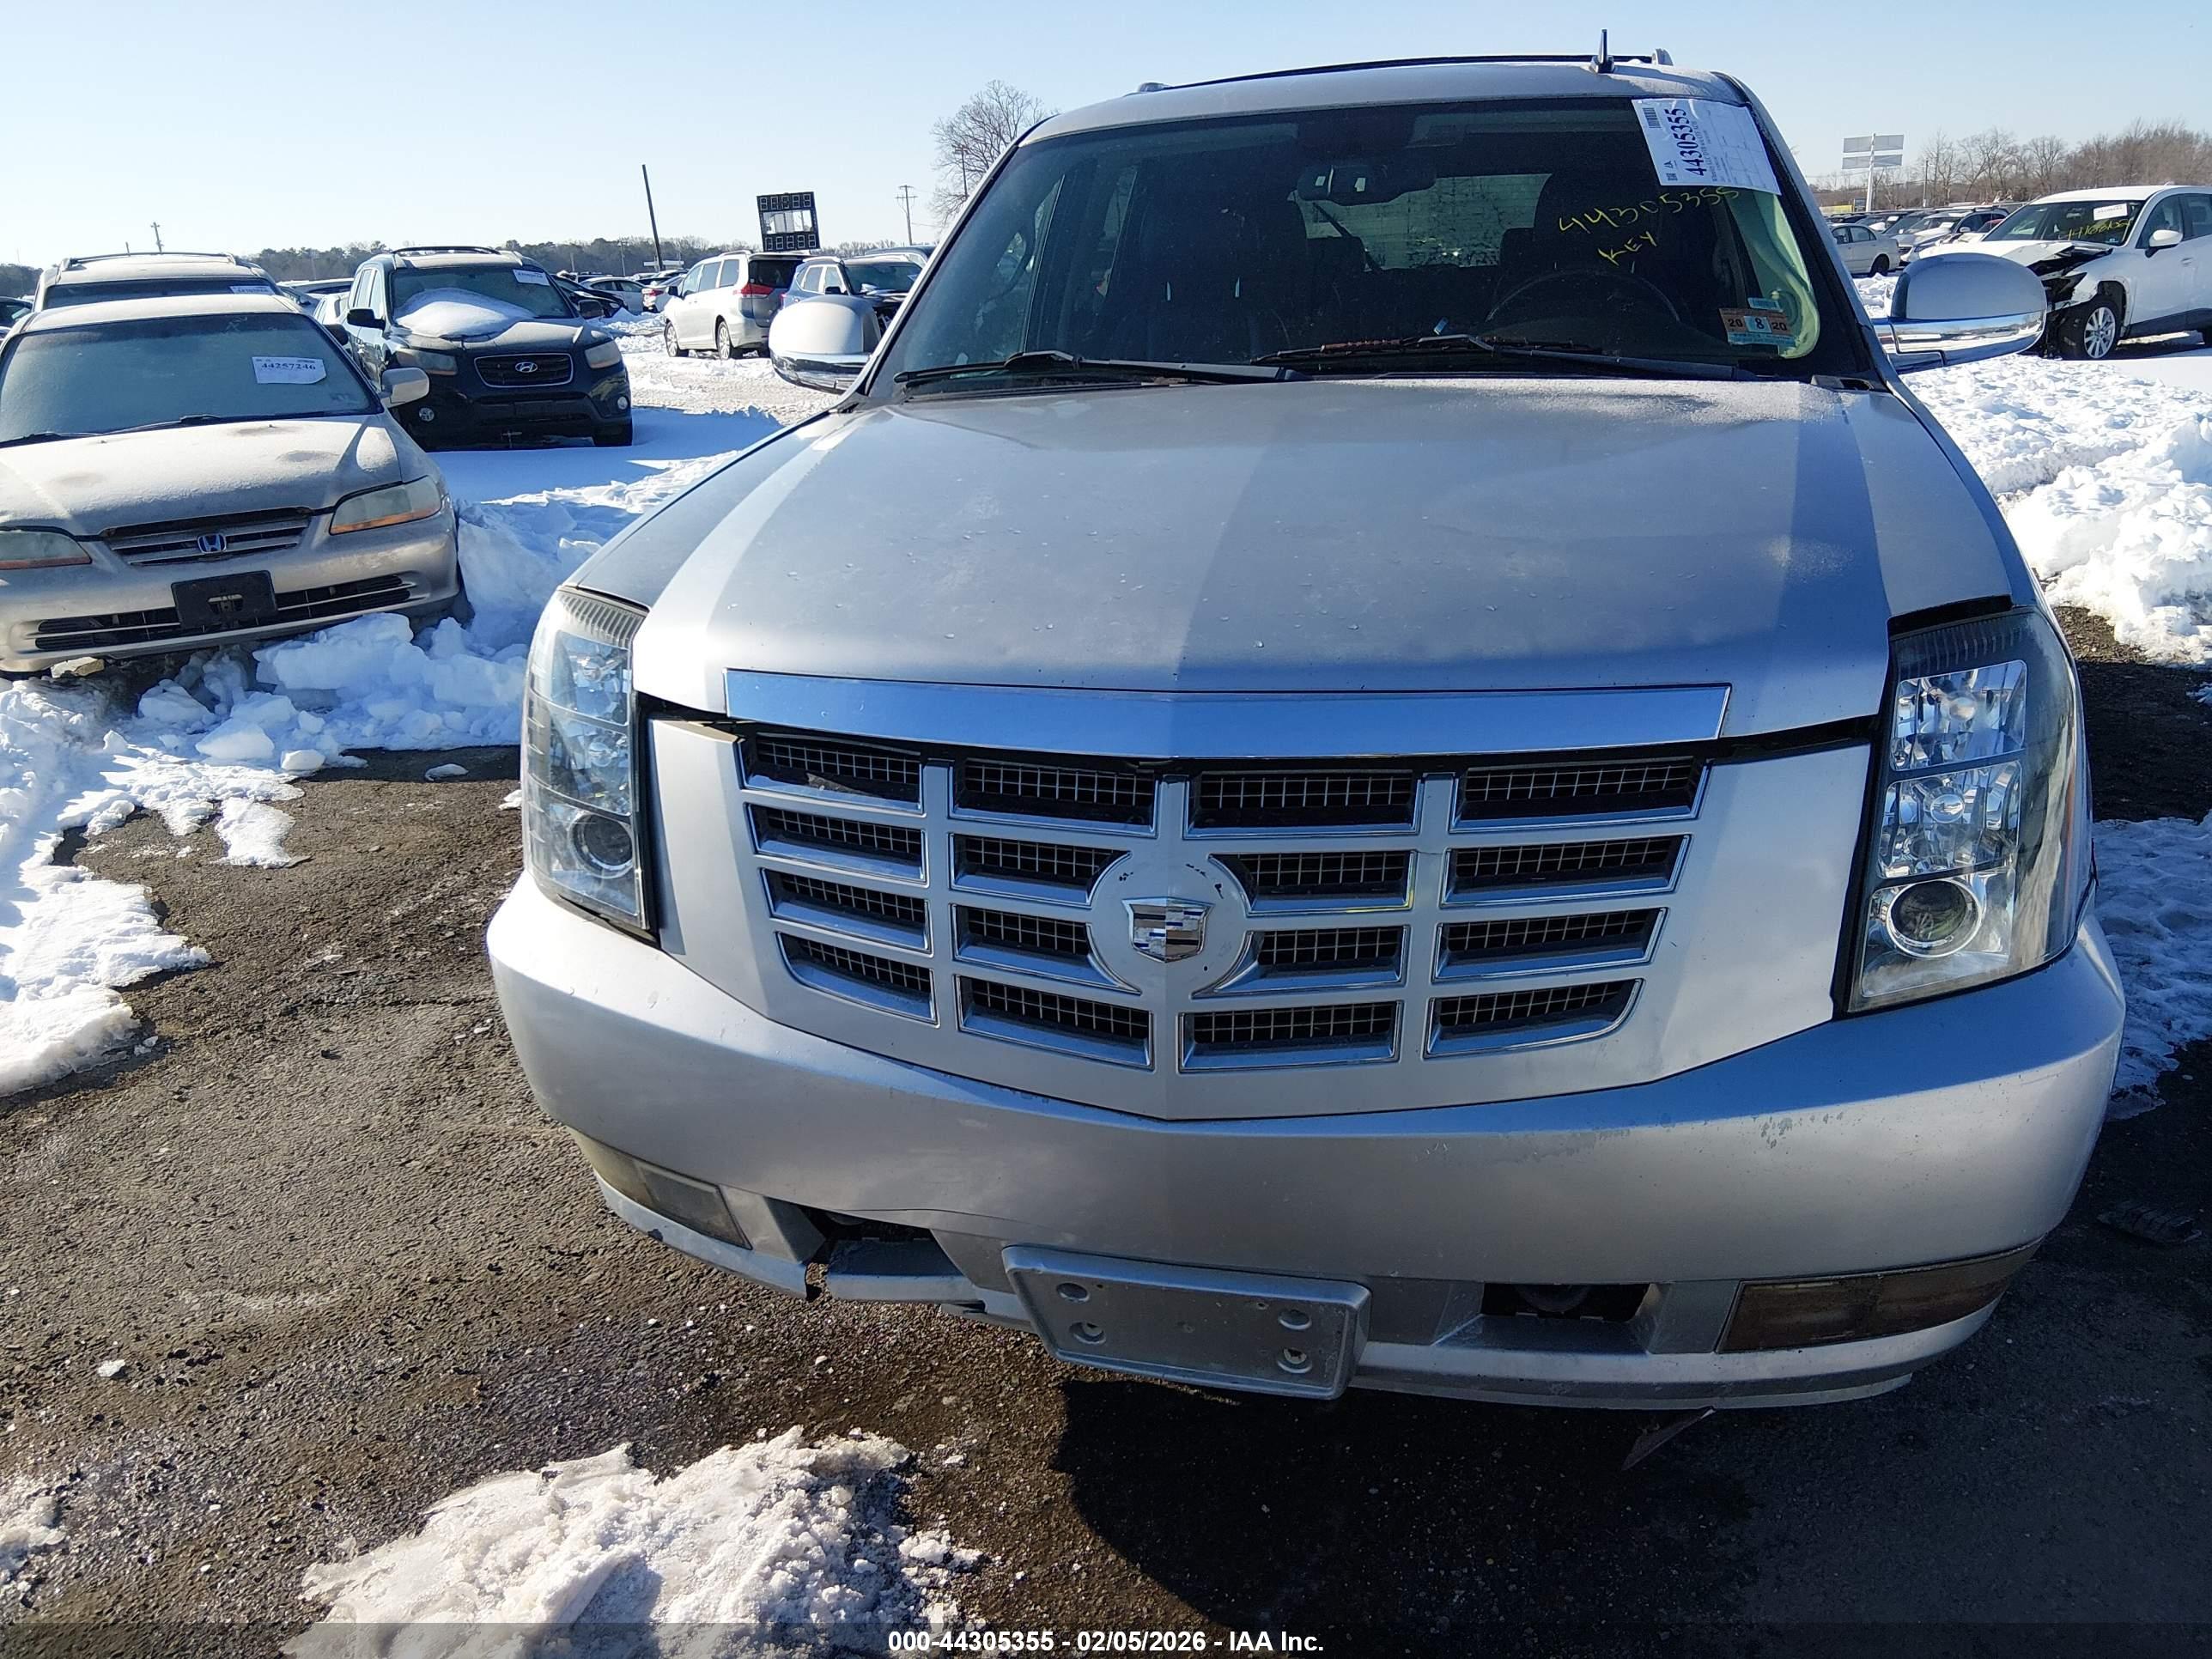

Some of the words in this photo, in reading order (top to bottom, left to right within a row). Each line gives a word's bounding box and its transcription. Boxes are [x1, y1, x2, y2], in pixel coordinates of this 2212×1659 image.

[1664, 108, 1707, 177] 44305355
[1559, 186, 1740, 234] 44305355
[1598, 231, 1657, 268] KEY
[1755, 318, 1765, 329] 8
